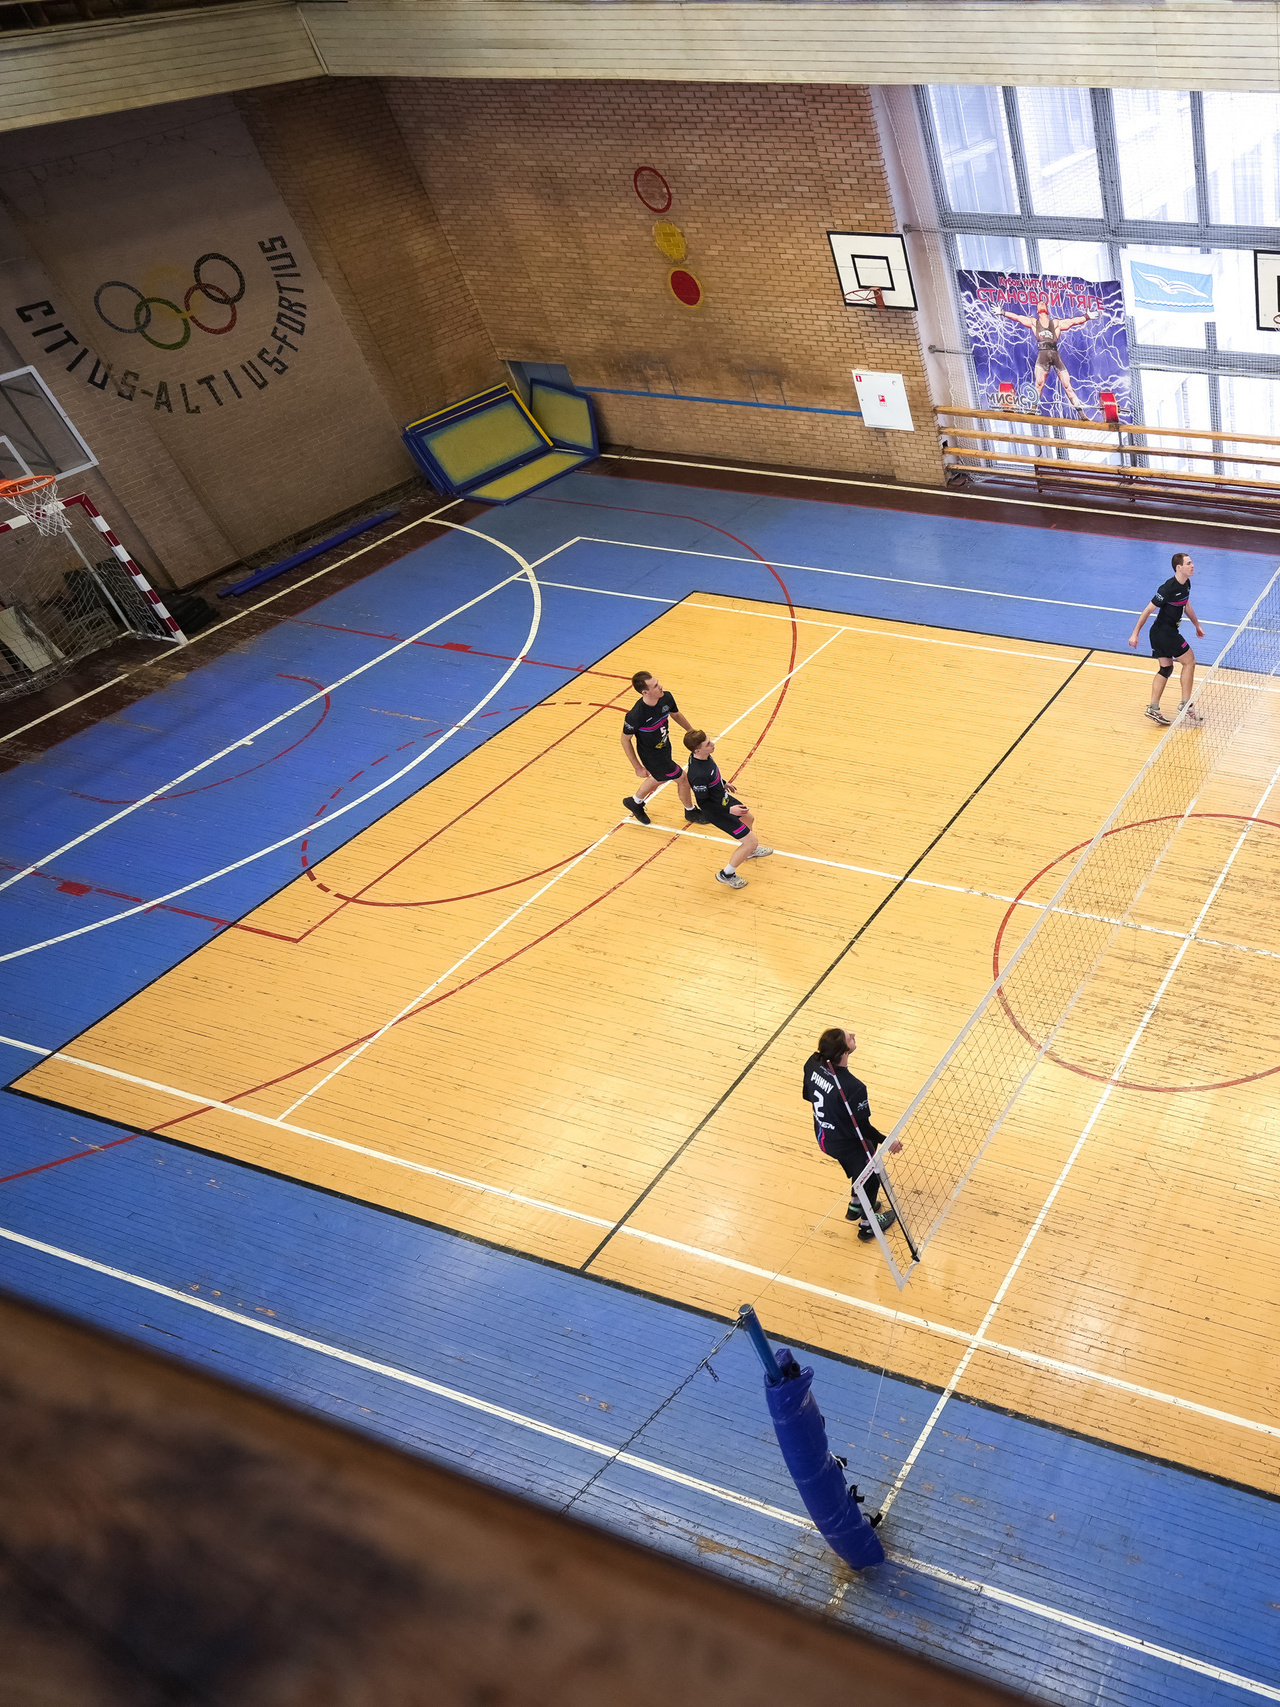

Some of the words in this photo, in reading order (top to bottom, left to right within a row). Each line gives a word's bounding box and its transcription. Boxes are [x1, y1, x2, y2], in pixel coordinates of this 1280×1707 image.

[998, 277, 1021, 289] Кубок
[1023, 279, 1042, 289] НИТУ
[976, 288, 1062, 307] СТАНОВОЙ
[1066, 293, 1105, 311] ТЯГЕ
[810, 1071, 834, 1094] РНИМУ
[813, 1090, 825, 1118] 2
